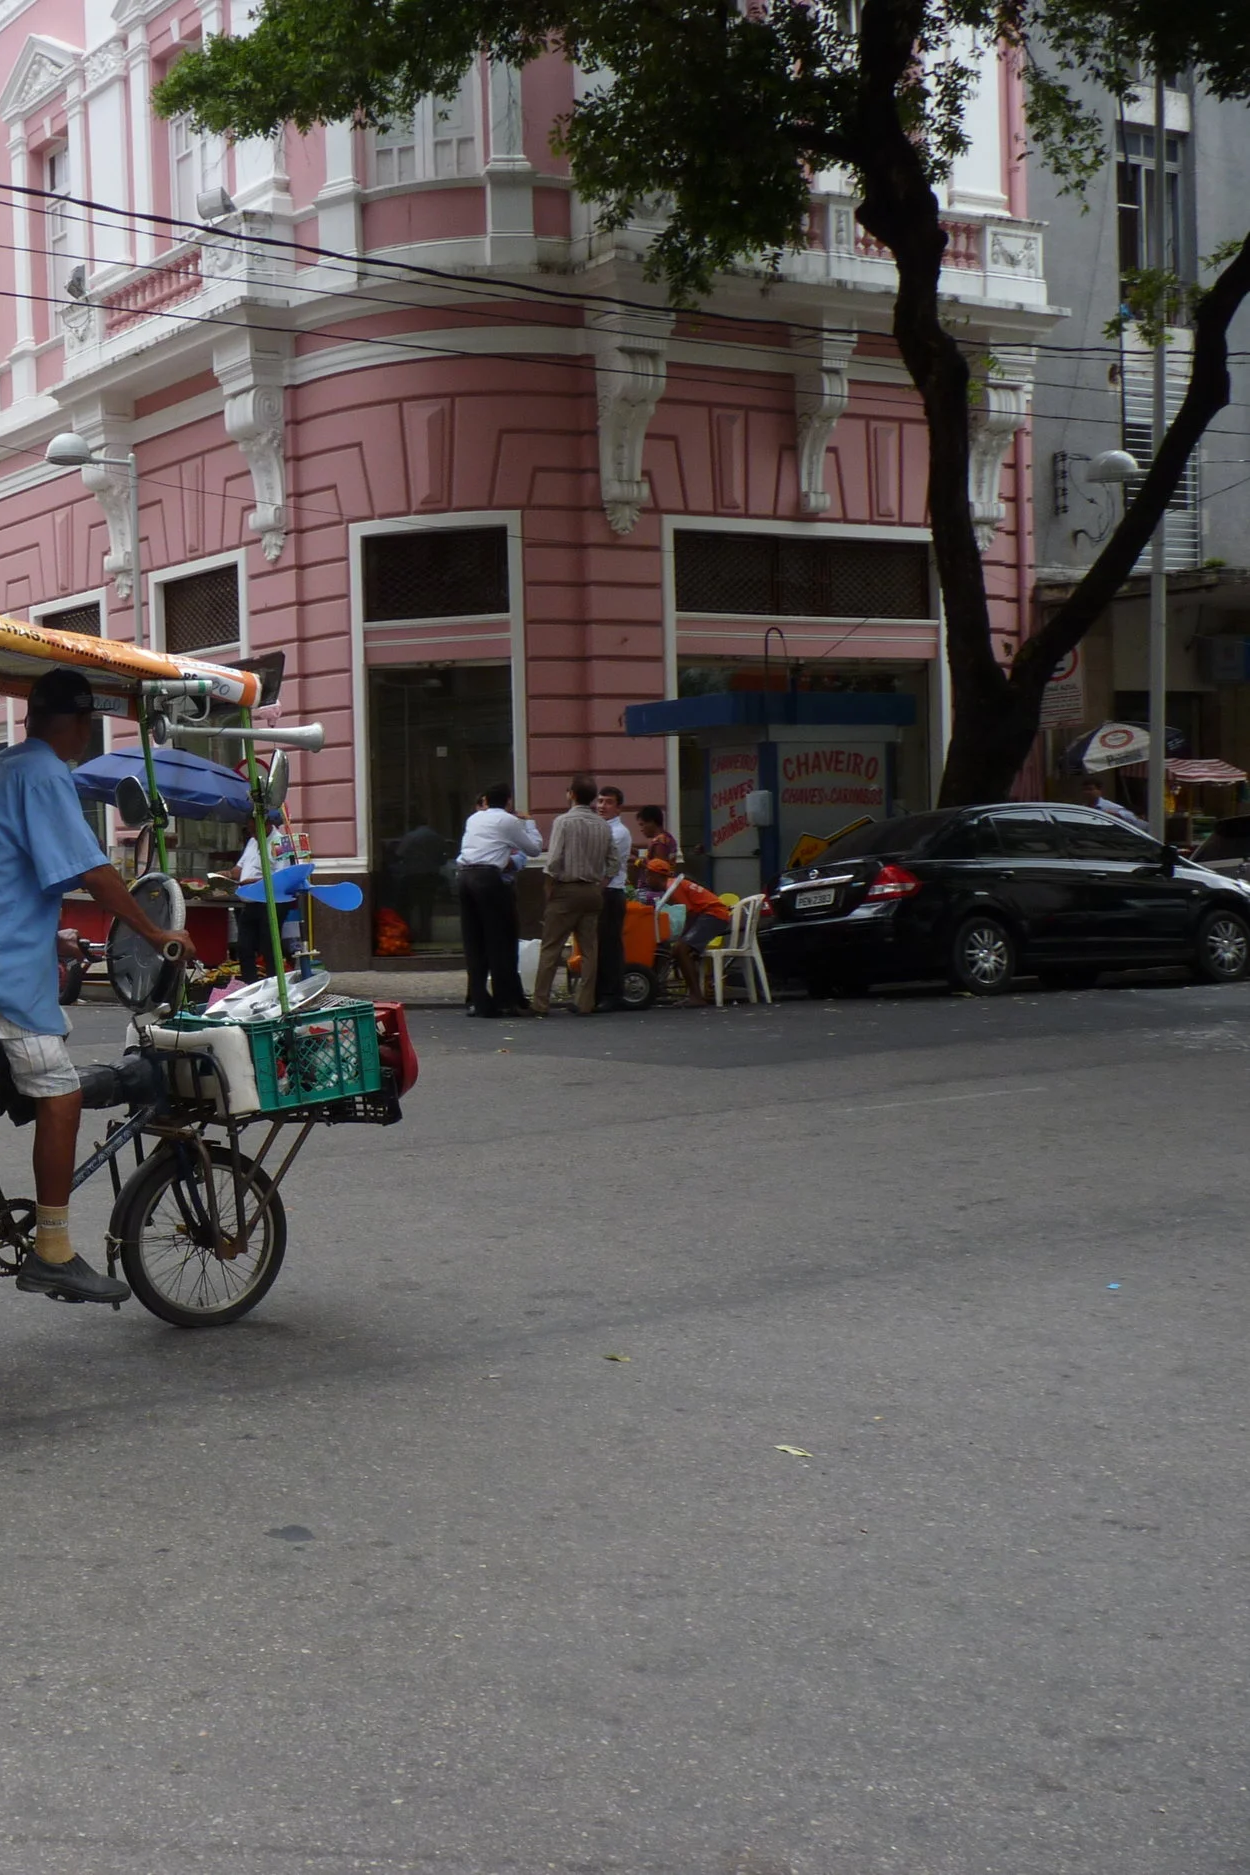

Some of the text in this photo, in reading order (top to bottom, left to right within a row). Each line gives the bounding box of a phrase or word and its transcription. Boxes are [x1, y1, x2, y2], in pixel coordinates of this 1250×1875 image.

[782, 749, 880, 782] CHAVEIRO
[711, 778, 755, 811] CHAVES
[729, 806, 737, 818] E
